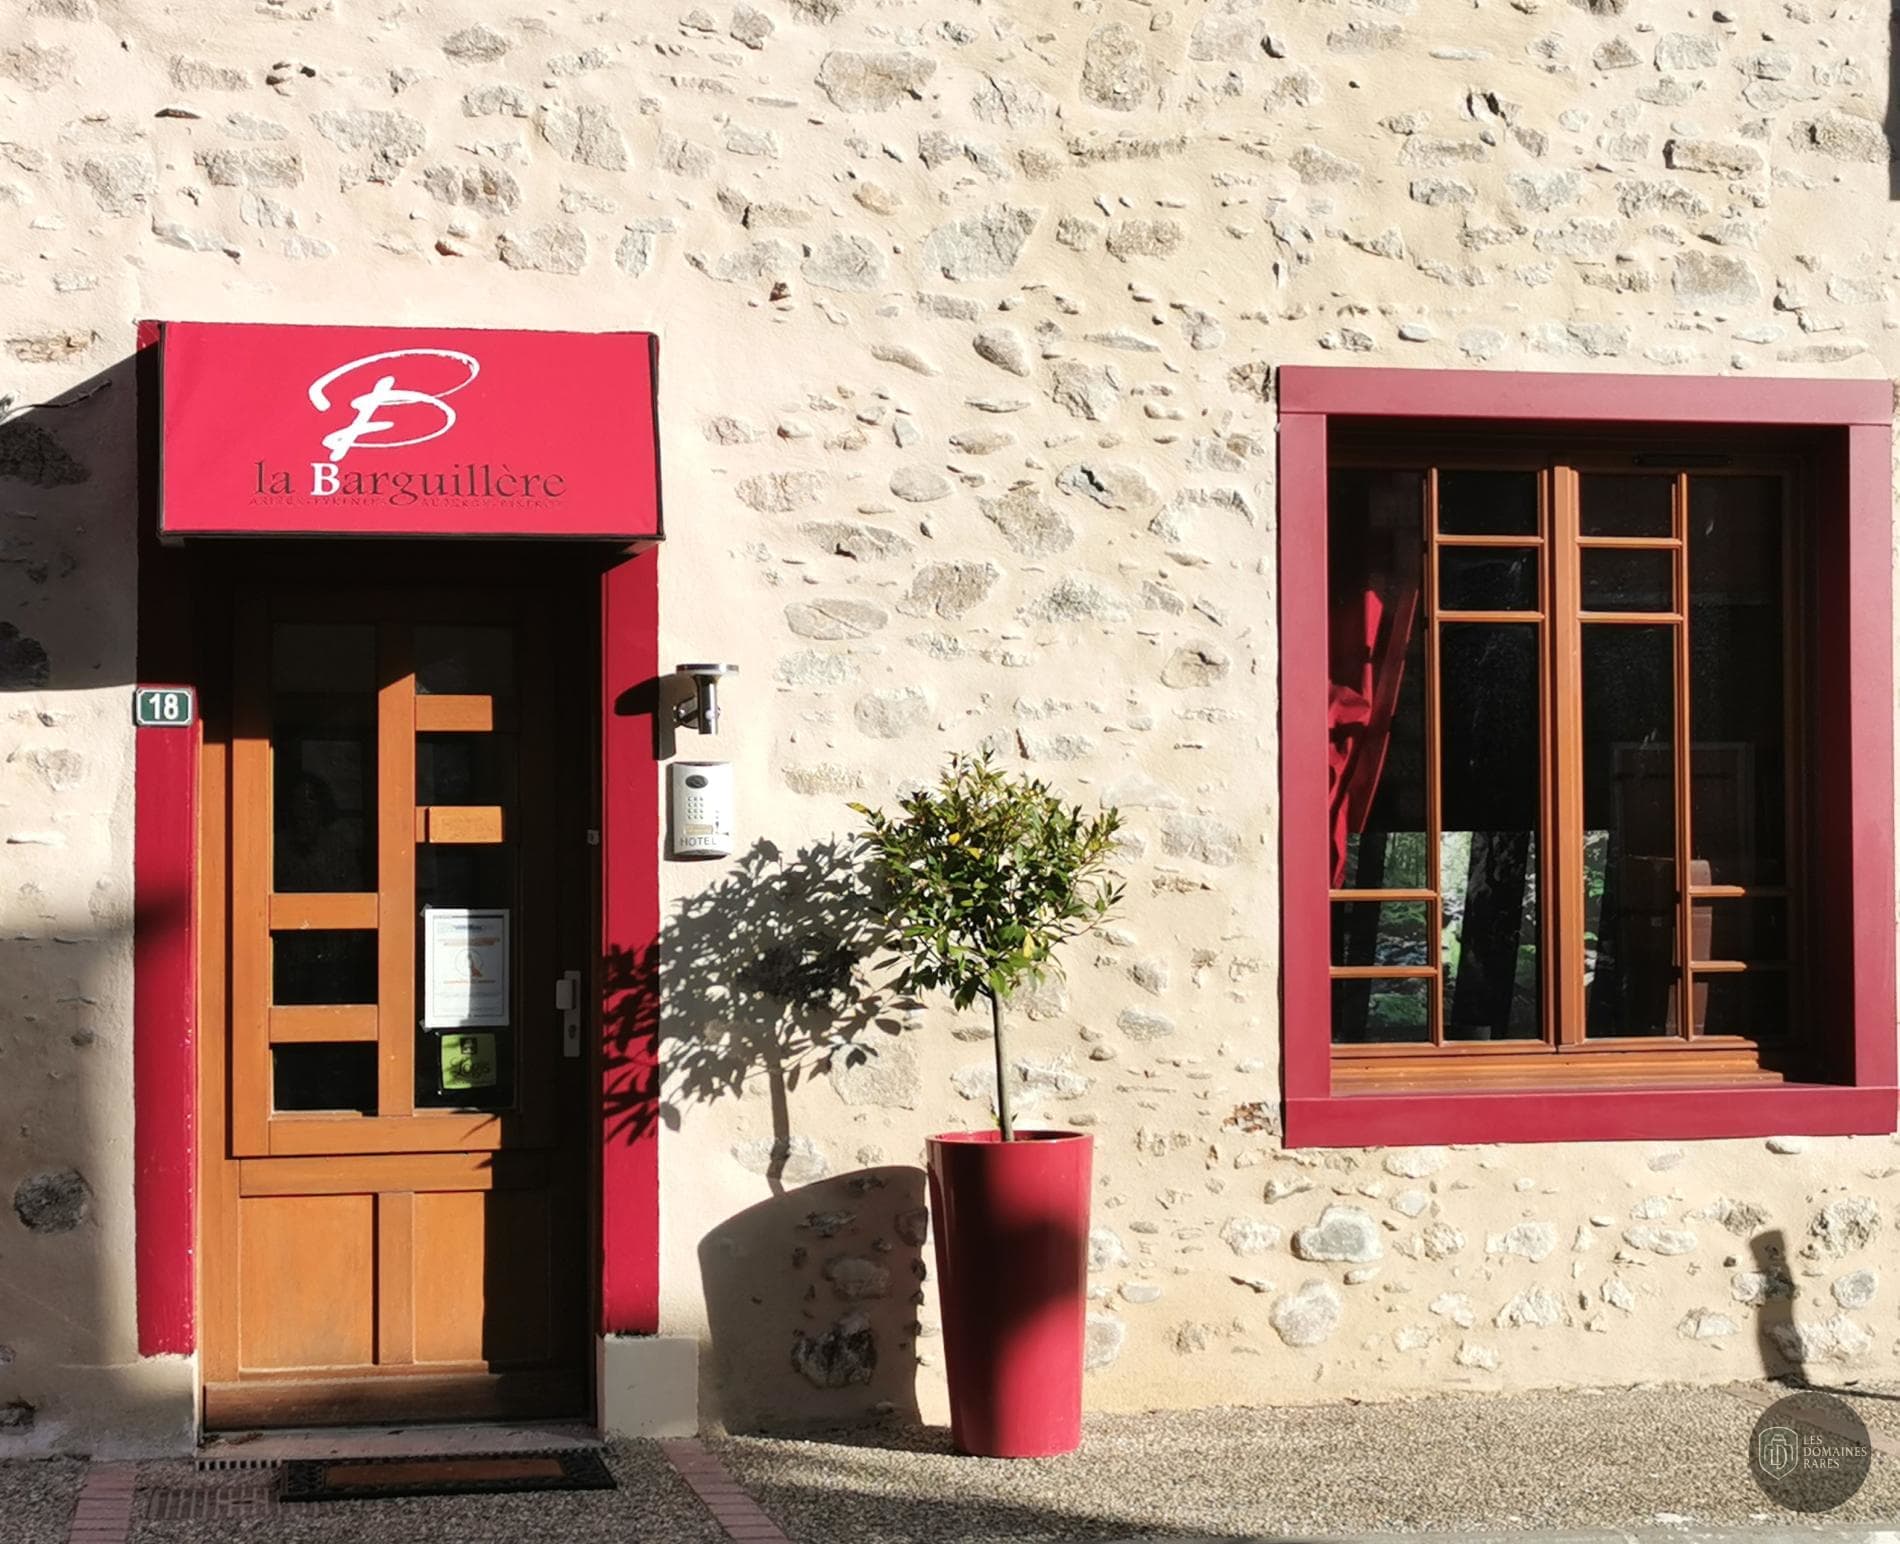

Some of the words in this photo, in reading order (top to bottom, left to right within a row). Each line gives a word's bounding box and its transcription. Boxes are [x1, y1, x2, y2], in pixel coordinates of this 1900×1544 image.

[254, 460, 295, 495] la
[310, 461, 567, 507] Barguillère
[148, 692, 179, 720] 18
[680, 837, 717, 847] HOTEL
